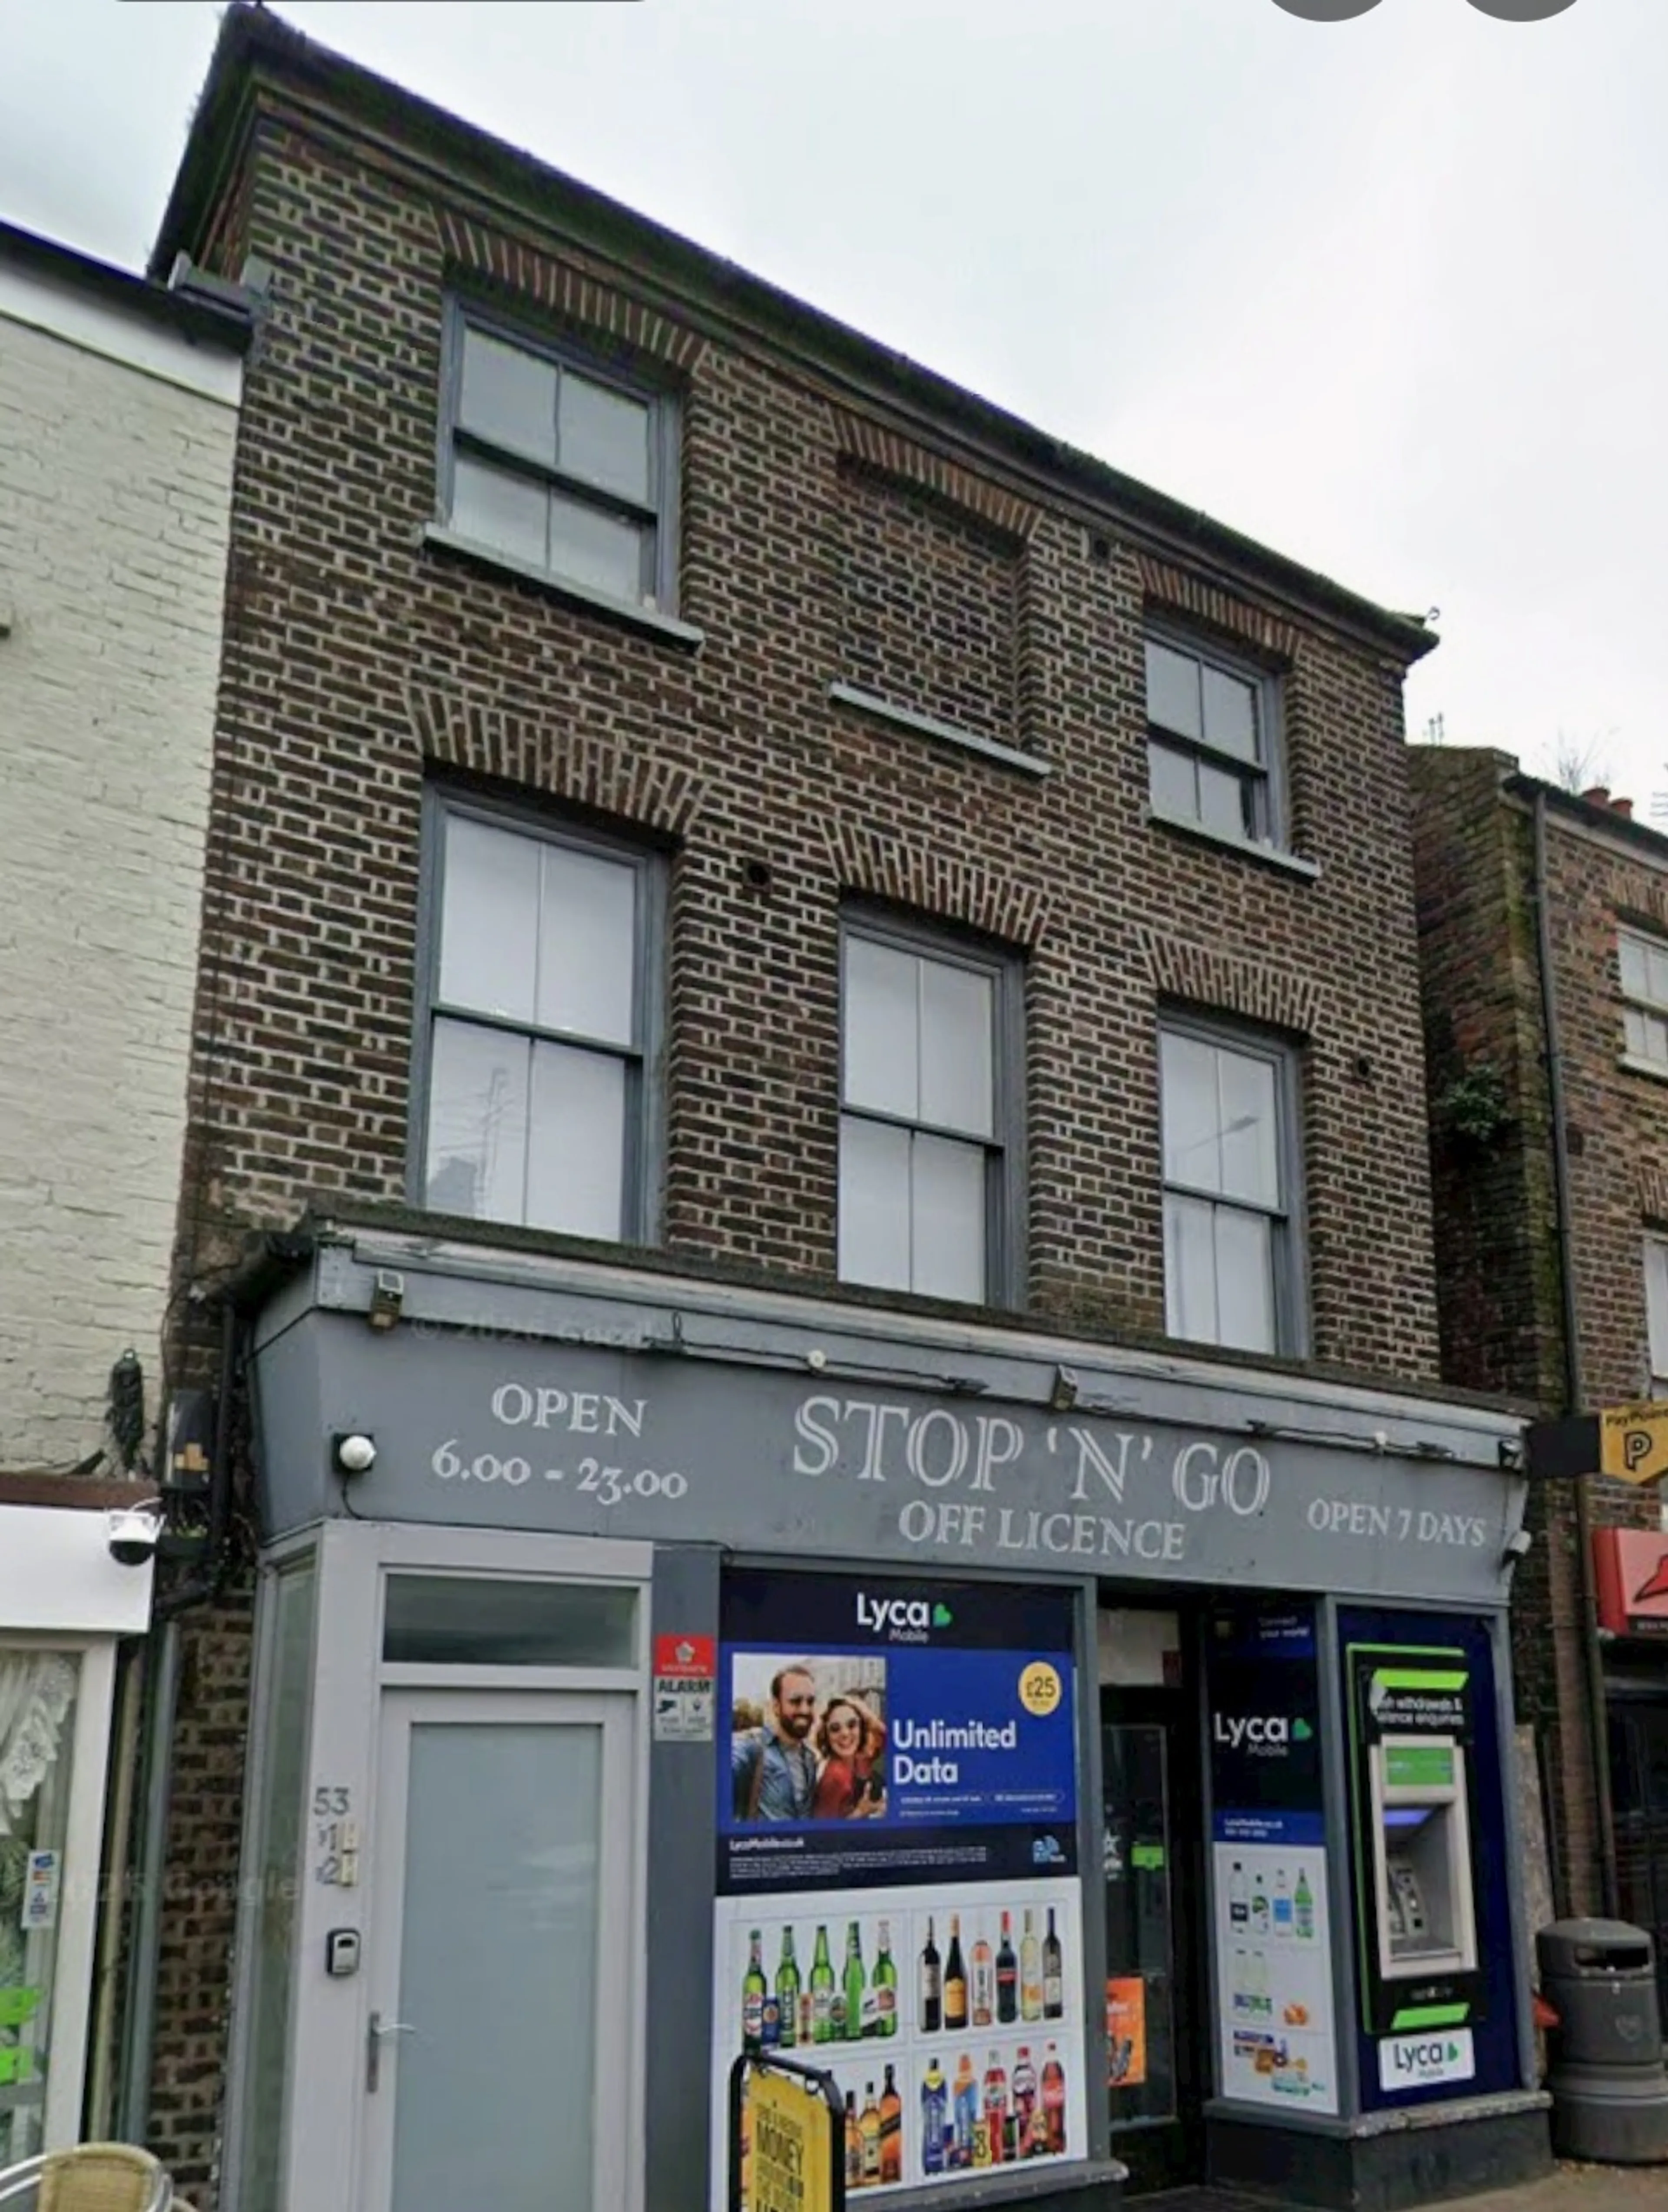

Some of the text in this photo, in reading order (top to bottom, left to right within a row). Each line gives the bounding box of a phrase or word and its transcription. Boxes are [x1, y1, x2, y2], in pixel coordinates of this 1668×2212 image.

[492, 1383, 648, 1437] OPEN
[431, 1439, 531, 1485] 6.00
[576, 1457, 688, 1504] 23.00
[794, 1396, 1024, 1491] STOP
[1172, 1441, 1271, 1515] GO
[898, 1500, 1186, 1560] OFF LICENCE
[1307, 1498, 1486, 1547] OPEN 7 DAYS
[857, 1592, 930, 1633] Lyca
[658, 1679, 711, 1693] ALARM
[1026, 1676, 1057, 1699] £25
[893, 1719, 1016, 1751] Unlimited
[1215, 1712, 1289, 1748] Lyca
[893, 1756, 958, 1785] Data
[313, 1787, 350, 1816] 53
[1393, 2042, 1443, 2073] Lyca
